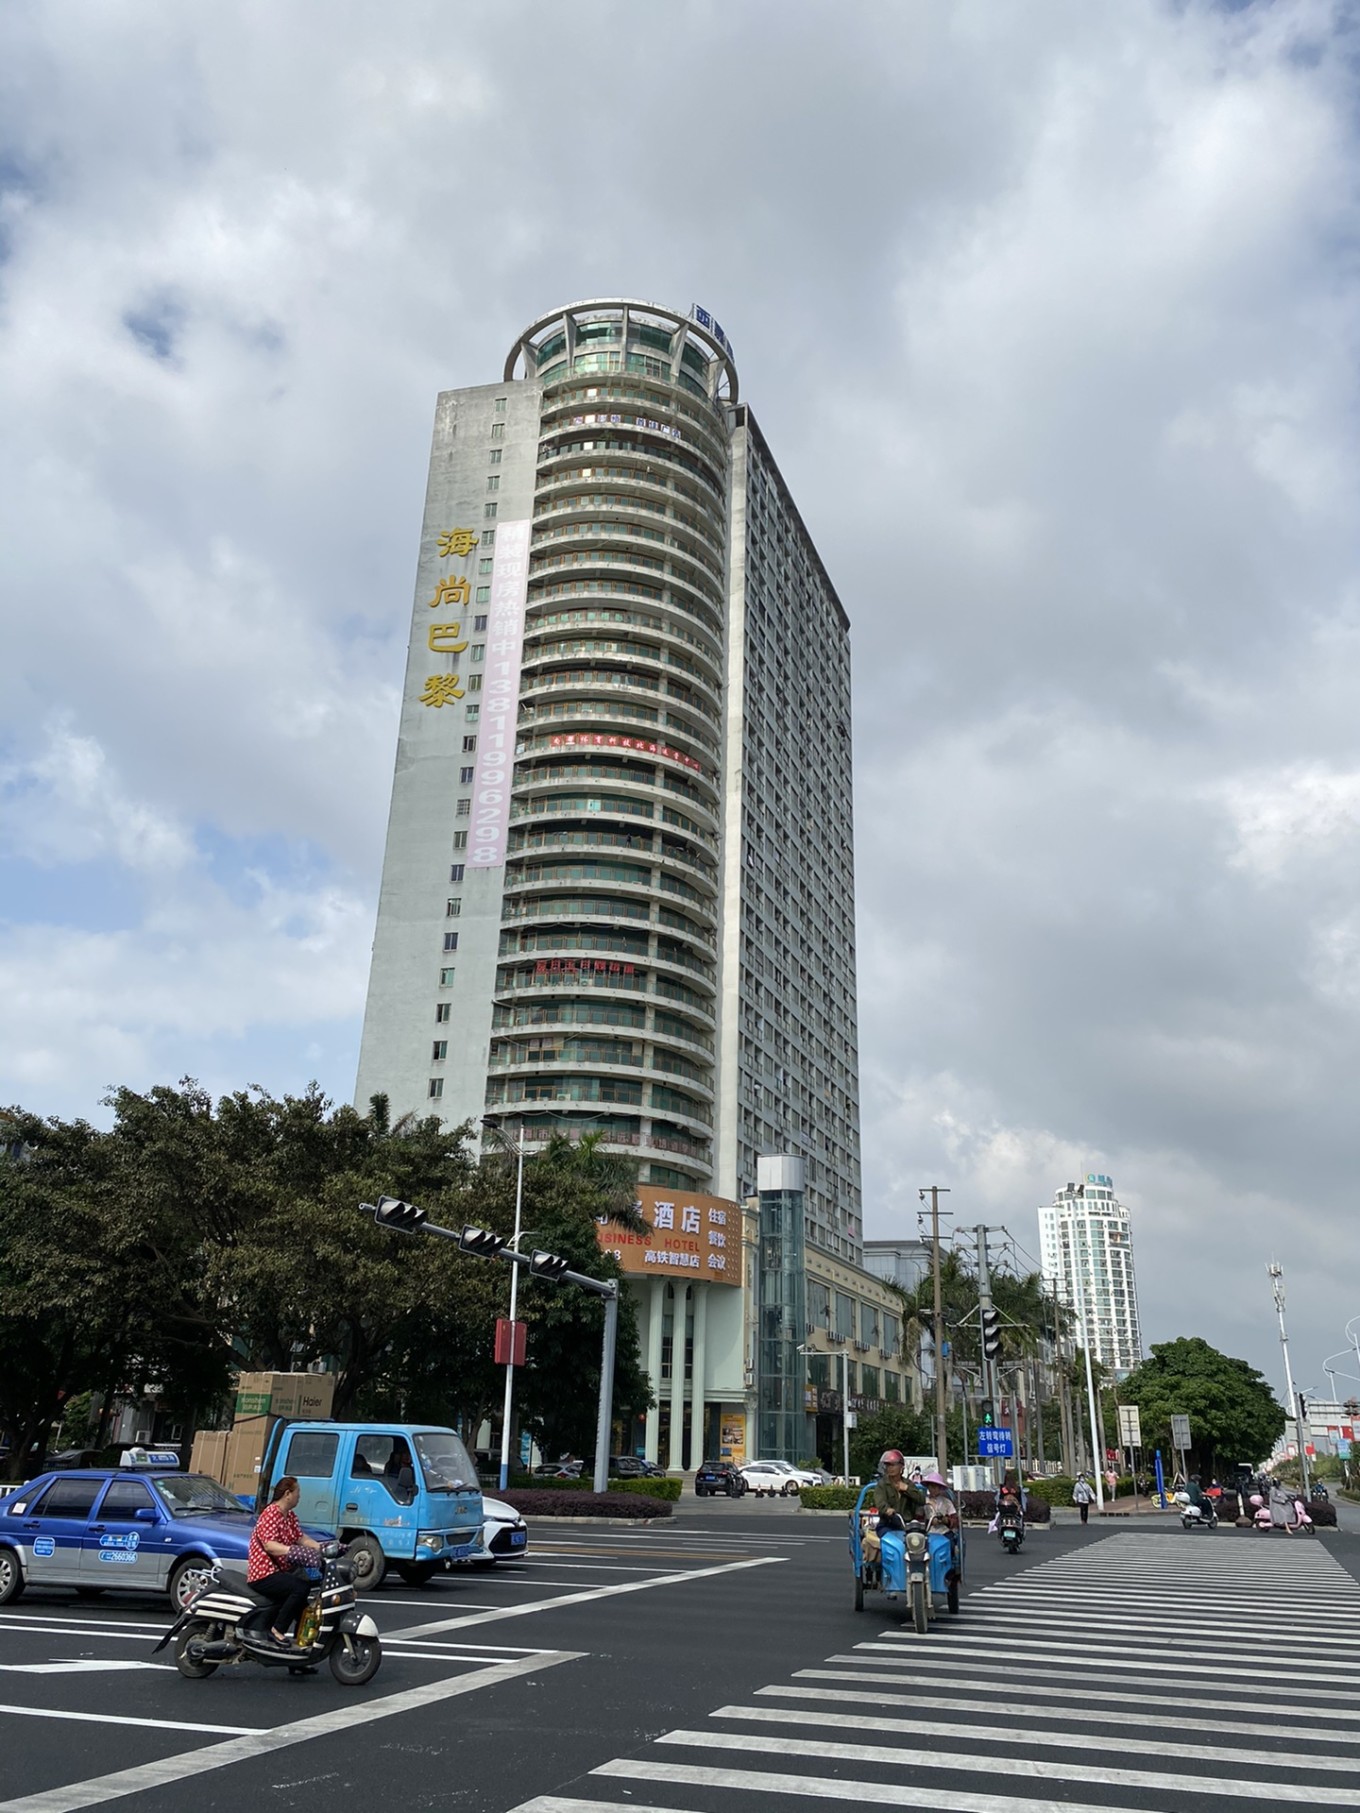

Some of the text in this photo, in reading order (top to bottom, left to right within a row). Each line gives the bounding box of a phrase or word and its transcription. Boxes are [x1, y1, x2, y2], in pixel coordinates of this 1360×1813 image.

[419, 526, 479, 708] 海尚巴黎
[708, 1208, 727, 1226] 住宿
[664, 1238, 700, 1252] HOTEL
[708, 1230, 727, 1248] 餐饮
[644, 1249, 701, 1268] 高铁智慧店
[707, 1253, 726, 1270] 会议
[303, 1395, 322, 1408] Haier
[986, 1443, 1006, 1453] 信号灯
